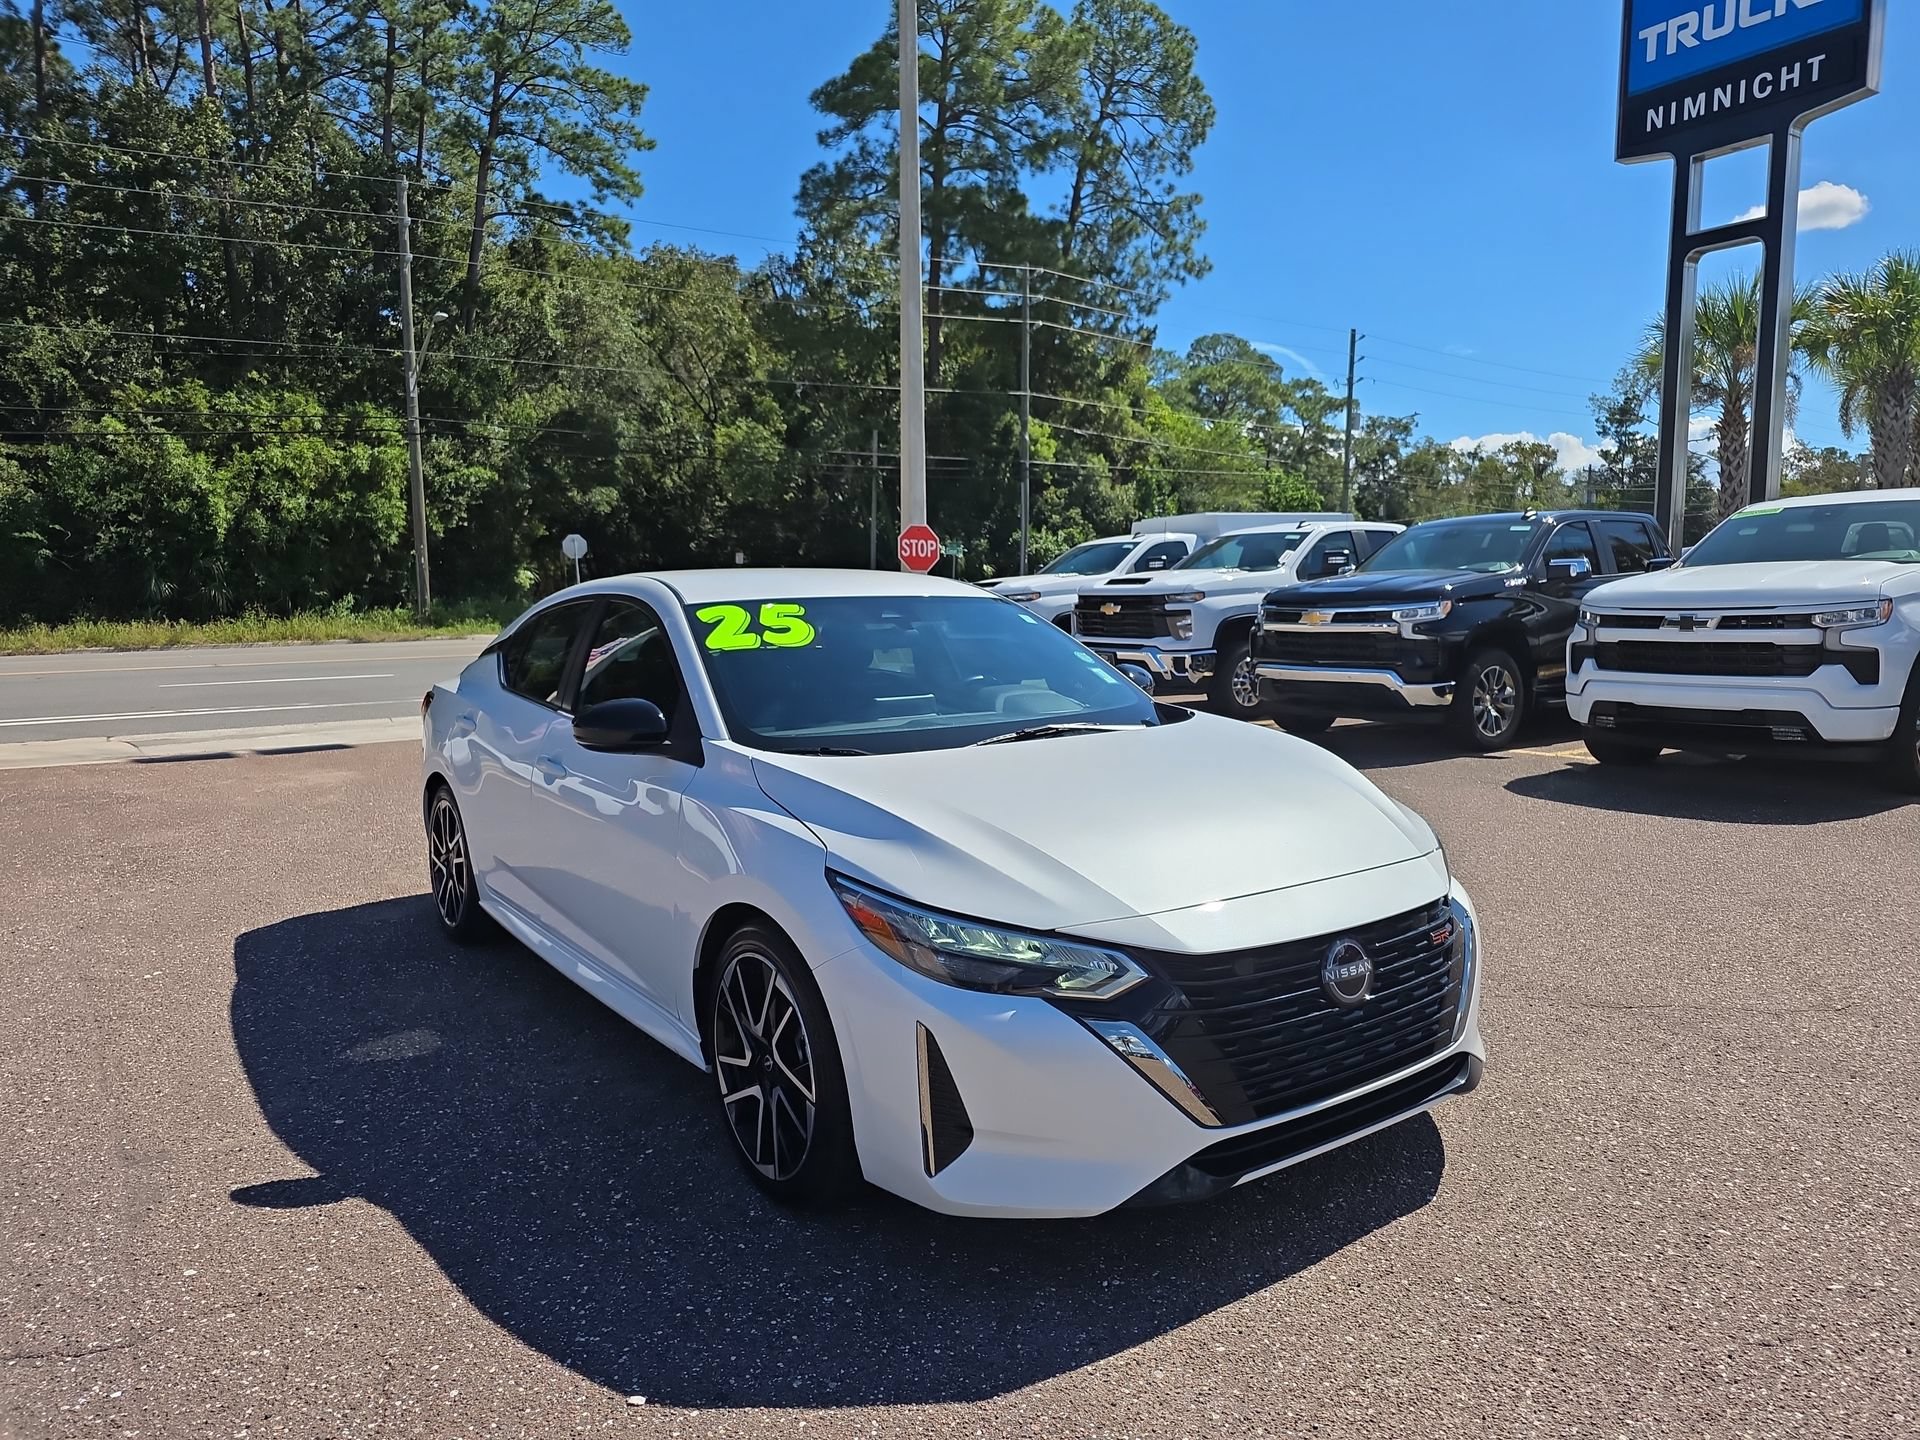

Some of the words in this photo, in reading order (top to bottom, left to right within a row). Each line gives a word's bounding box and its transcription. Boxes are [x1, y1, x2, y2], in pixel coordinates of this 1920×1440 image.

[1645, 54, 1826, 132] NIMNICHT
[901, 538, 937, 558] STOP
[695, 604, 816, 651] 25
[1325, 960, 1372, 981] NISSAN
